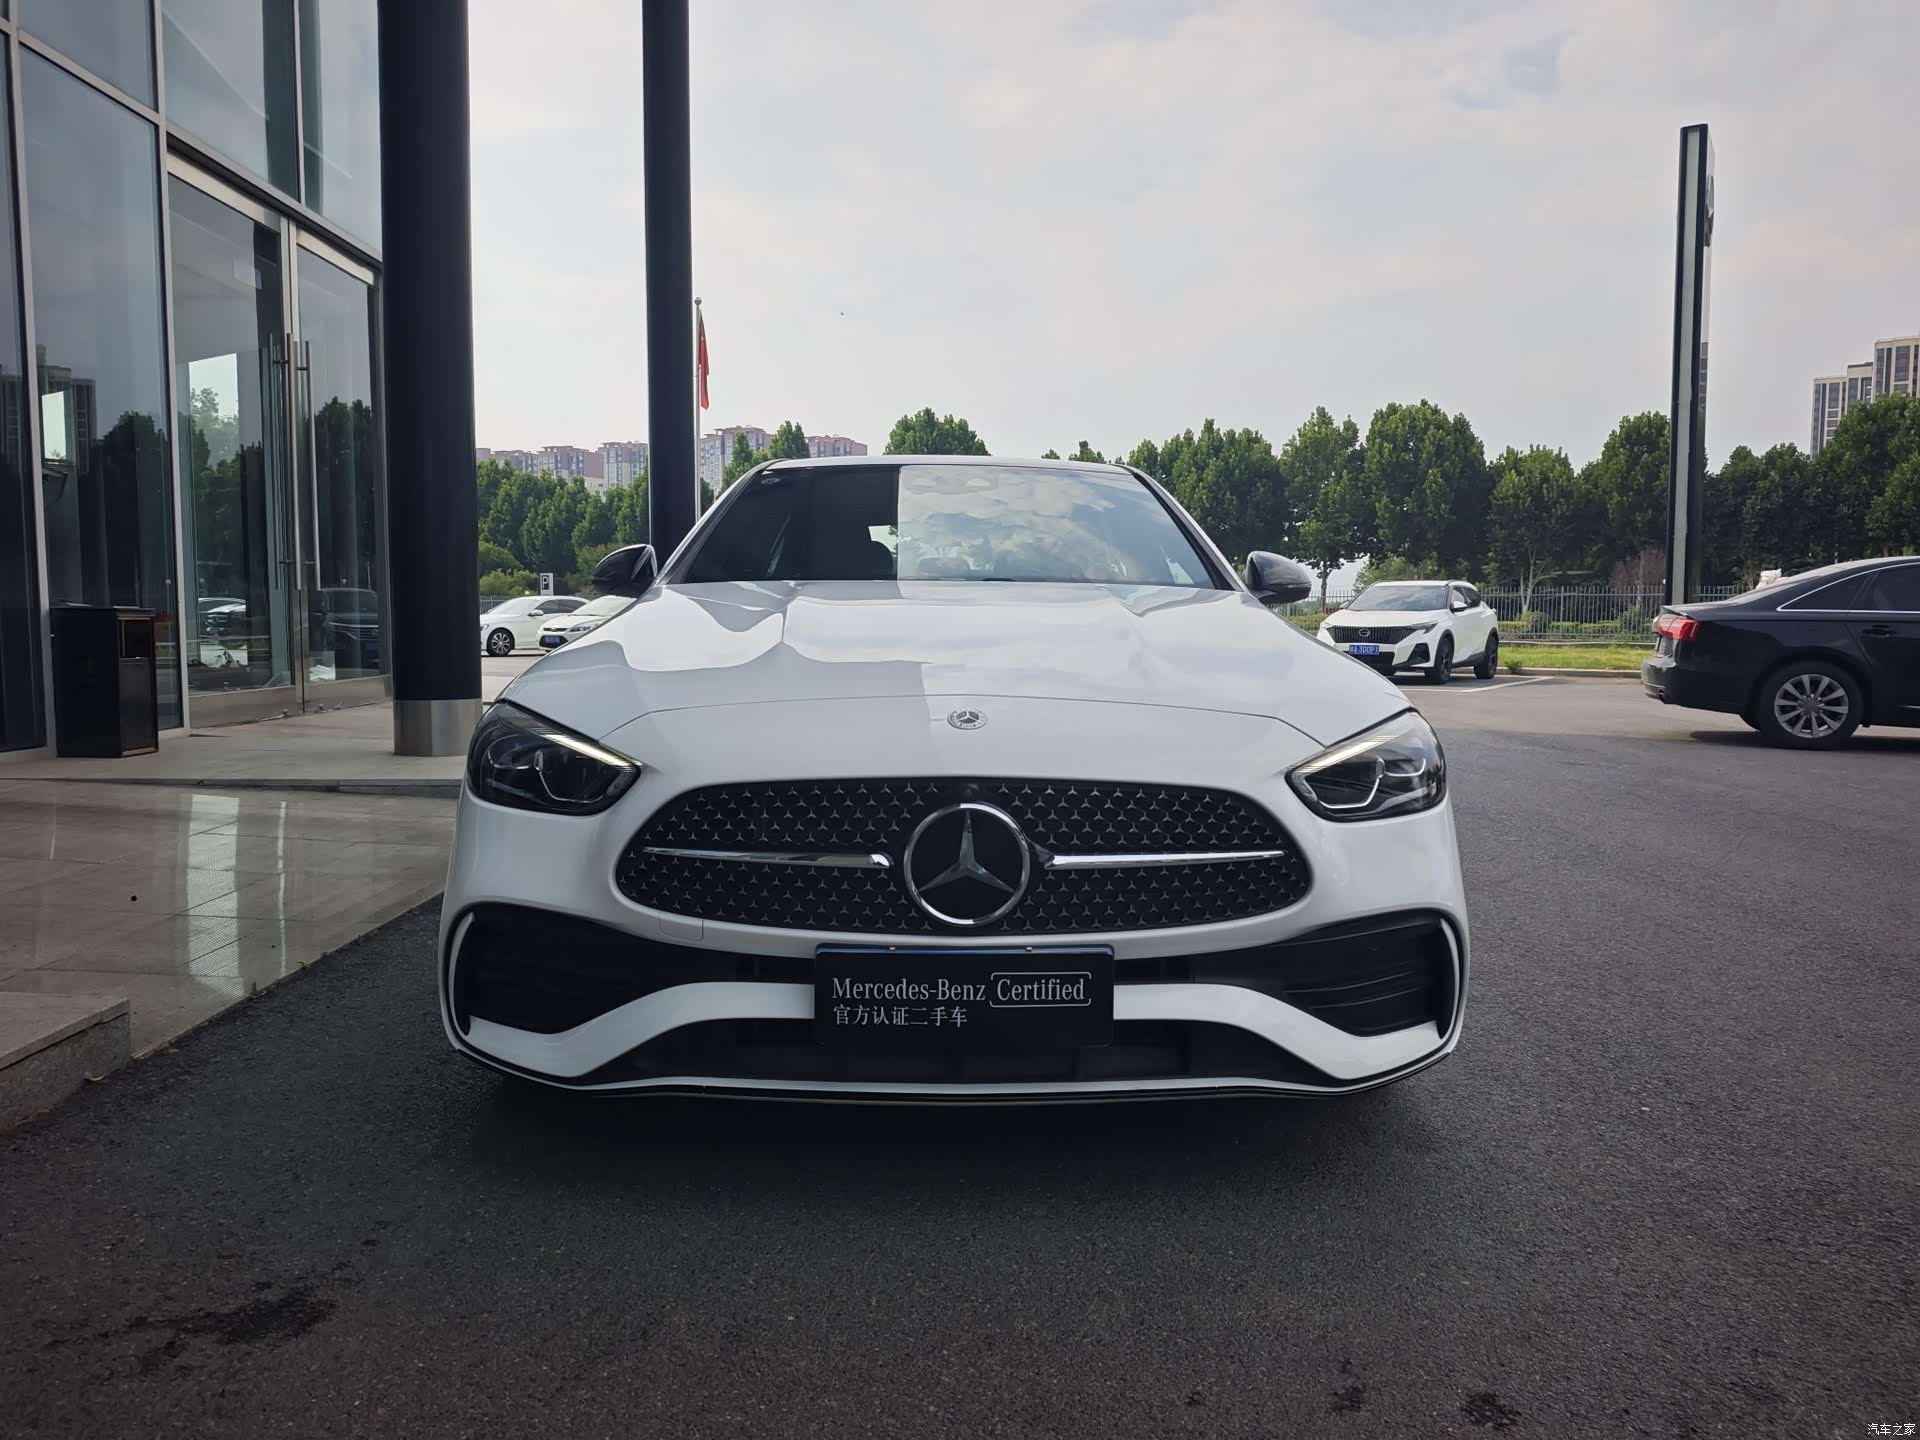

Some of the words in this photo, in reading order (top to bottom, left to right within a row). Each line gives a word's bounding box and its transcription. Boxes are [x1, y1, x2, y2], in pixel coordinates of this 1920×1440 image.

[542, 576, 549, 589] P
[831, 977, 986, 1001] Mercedes-Benz
[996, 977, 1085, 1001] Certified
[833, 1004, 968, 1027] 官方认证二手车
